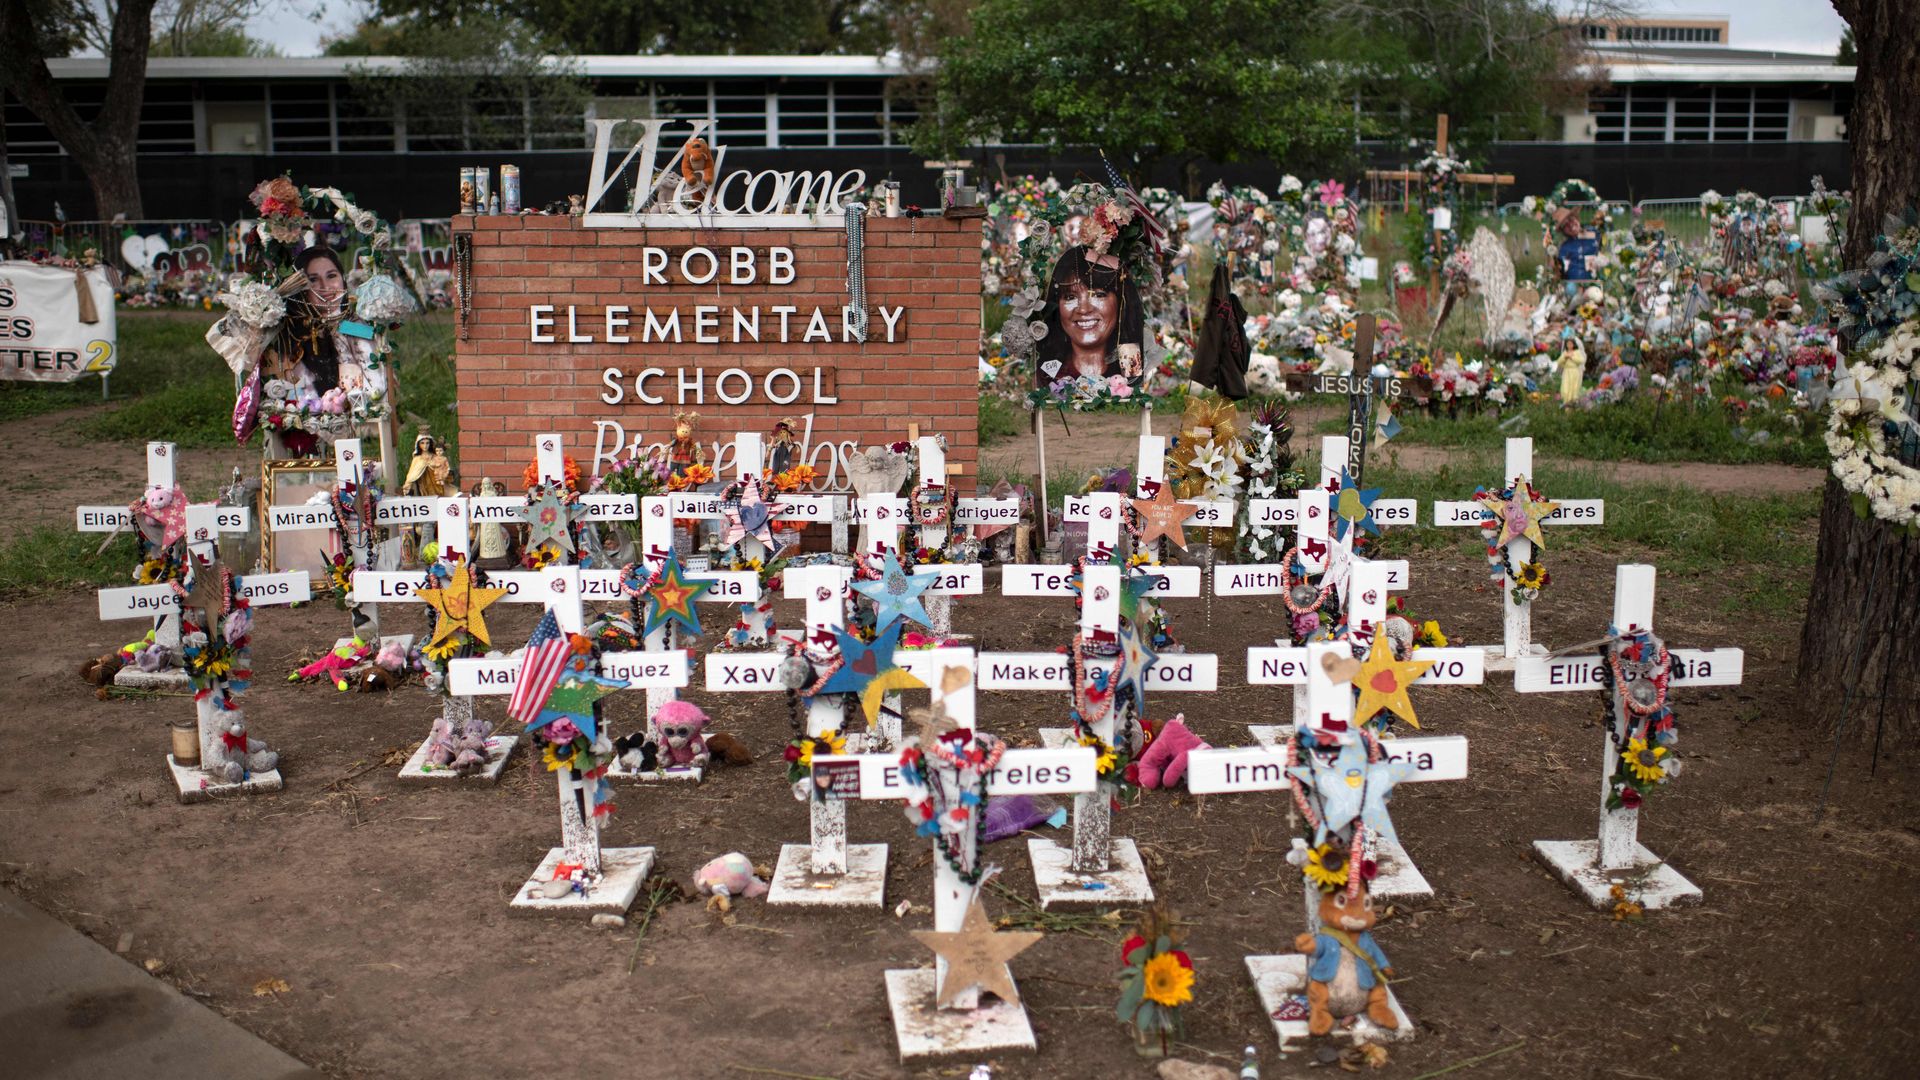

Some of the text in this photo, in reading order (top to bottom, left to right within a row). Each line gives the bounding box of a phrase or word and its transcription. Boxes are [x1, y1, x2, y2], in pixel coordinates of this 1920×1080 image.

[584, 119, 867, 216] Welcome
[643, 246, 796, 285] ROBB
[530, 304, 904, 344] ELEMENTARY
[86, 340, 113, 371] 2
[602, 367, 838, 405] SCHOOL
[1314, 376, 1402, 396] JESUS IS
[376, 504, 430, 520] athis
[474, 502, 635, 518] Ame arza
[677, 500, 722, 514] Jaila
[1261, 506, 1298, 520] Jos
[1546, 506, 1596, 519] ares
[380, 579, 427, 596] Lex
[1031, 573, 1074, 591] Tes
[128, 594, 180, 610] Jayce
[478, 668, 516, 686] Mai
[723, 665, 775, 683] Xav
[1144, 663, 1193, 682] rod
[1262, 658, 1308, 678] Nev
[1550, 662, 1604, 685] Ellie
[988, 764, 1072, 785] reles
[1225, 761, 1288, 784] Irm
